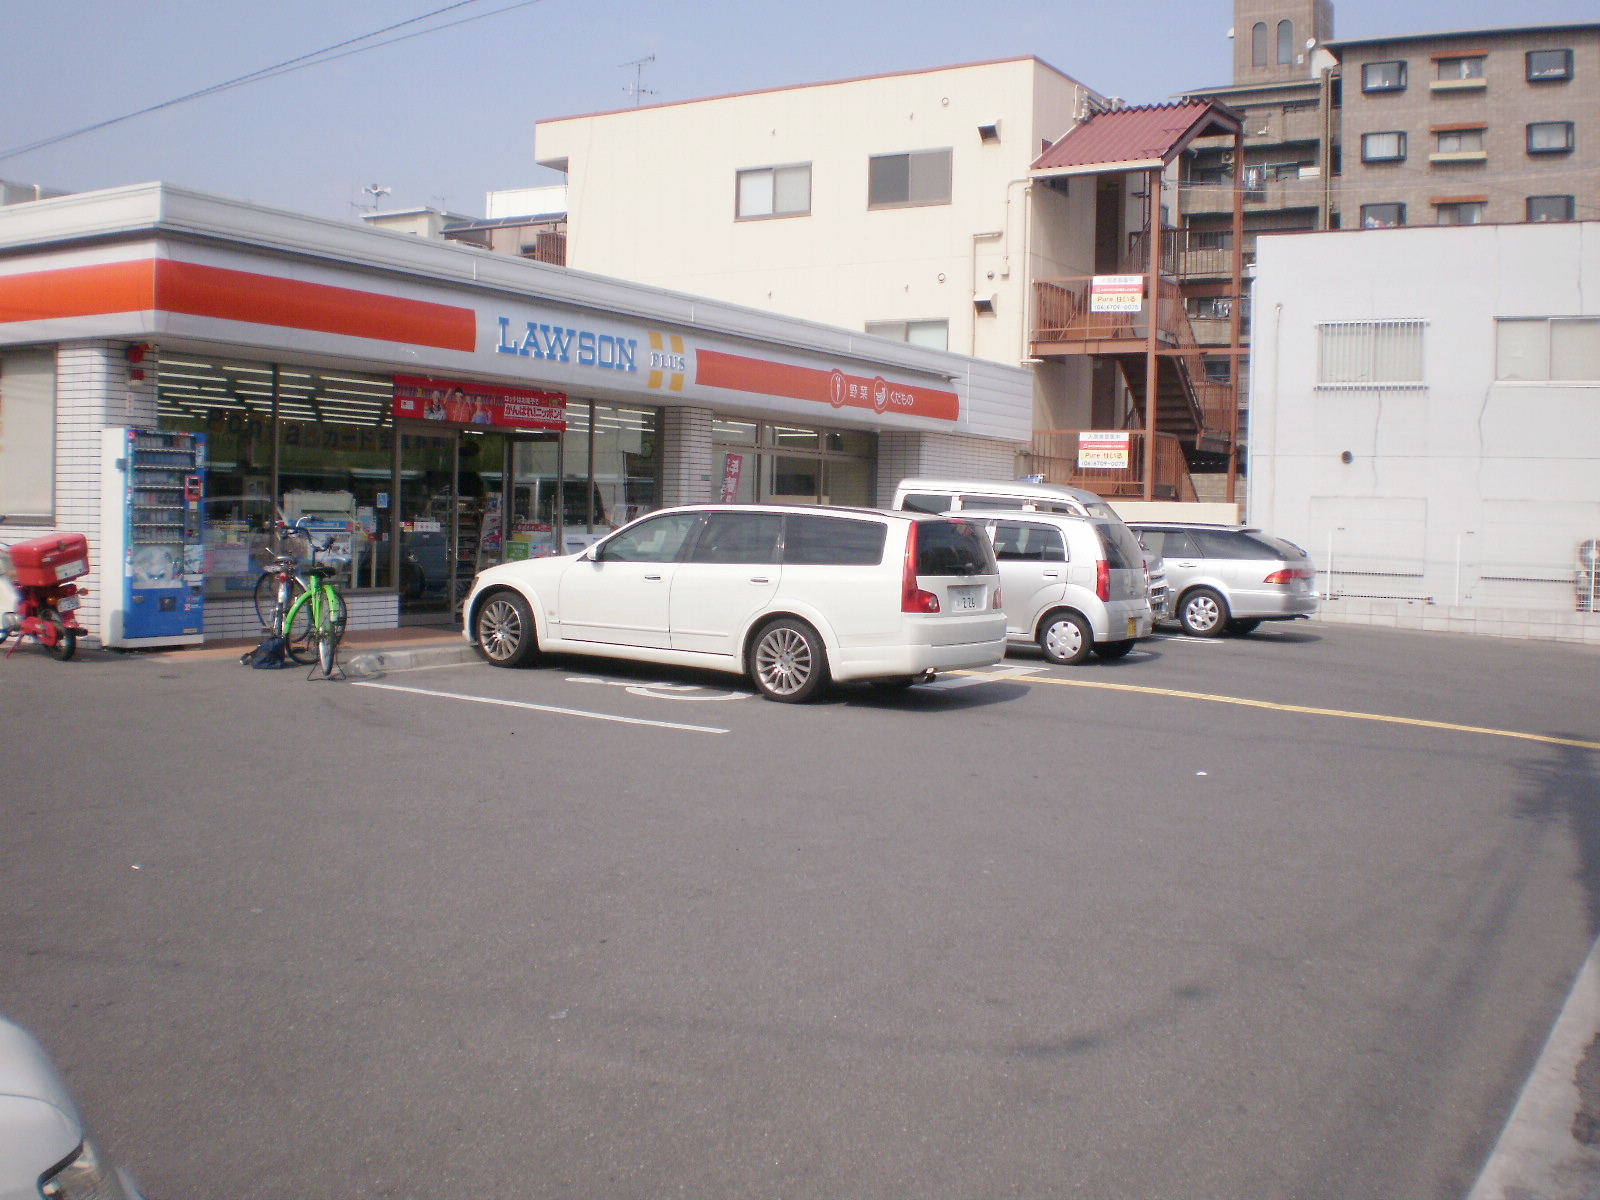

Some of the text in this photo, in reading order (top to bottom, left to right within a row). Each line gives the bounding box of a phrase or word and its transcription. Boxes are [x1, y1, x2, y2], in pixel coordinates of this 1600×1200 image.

[496, 317, 686, 371] LAWSON PLUS
[850, 384, 914, 405] 野菜 くだもの
